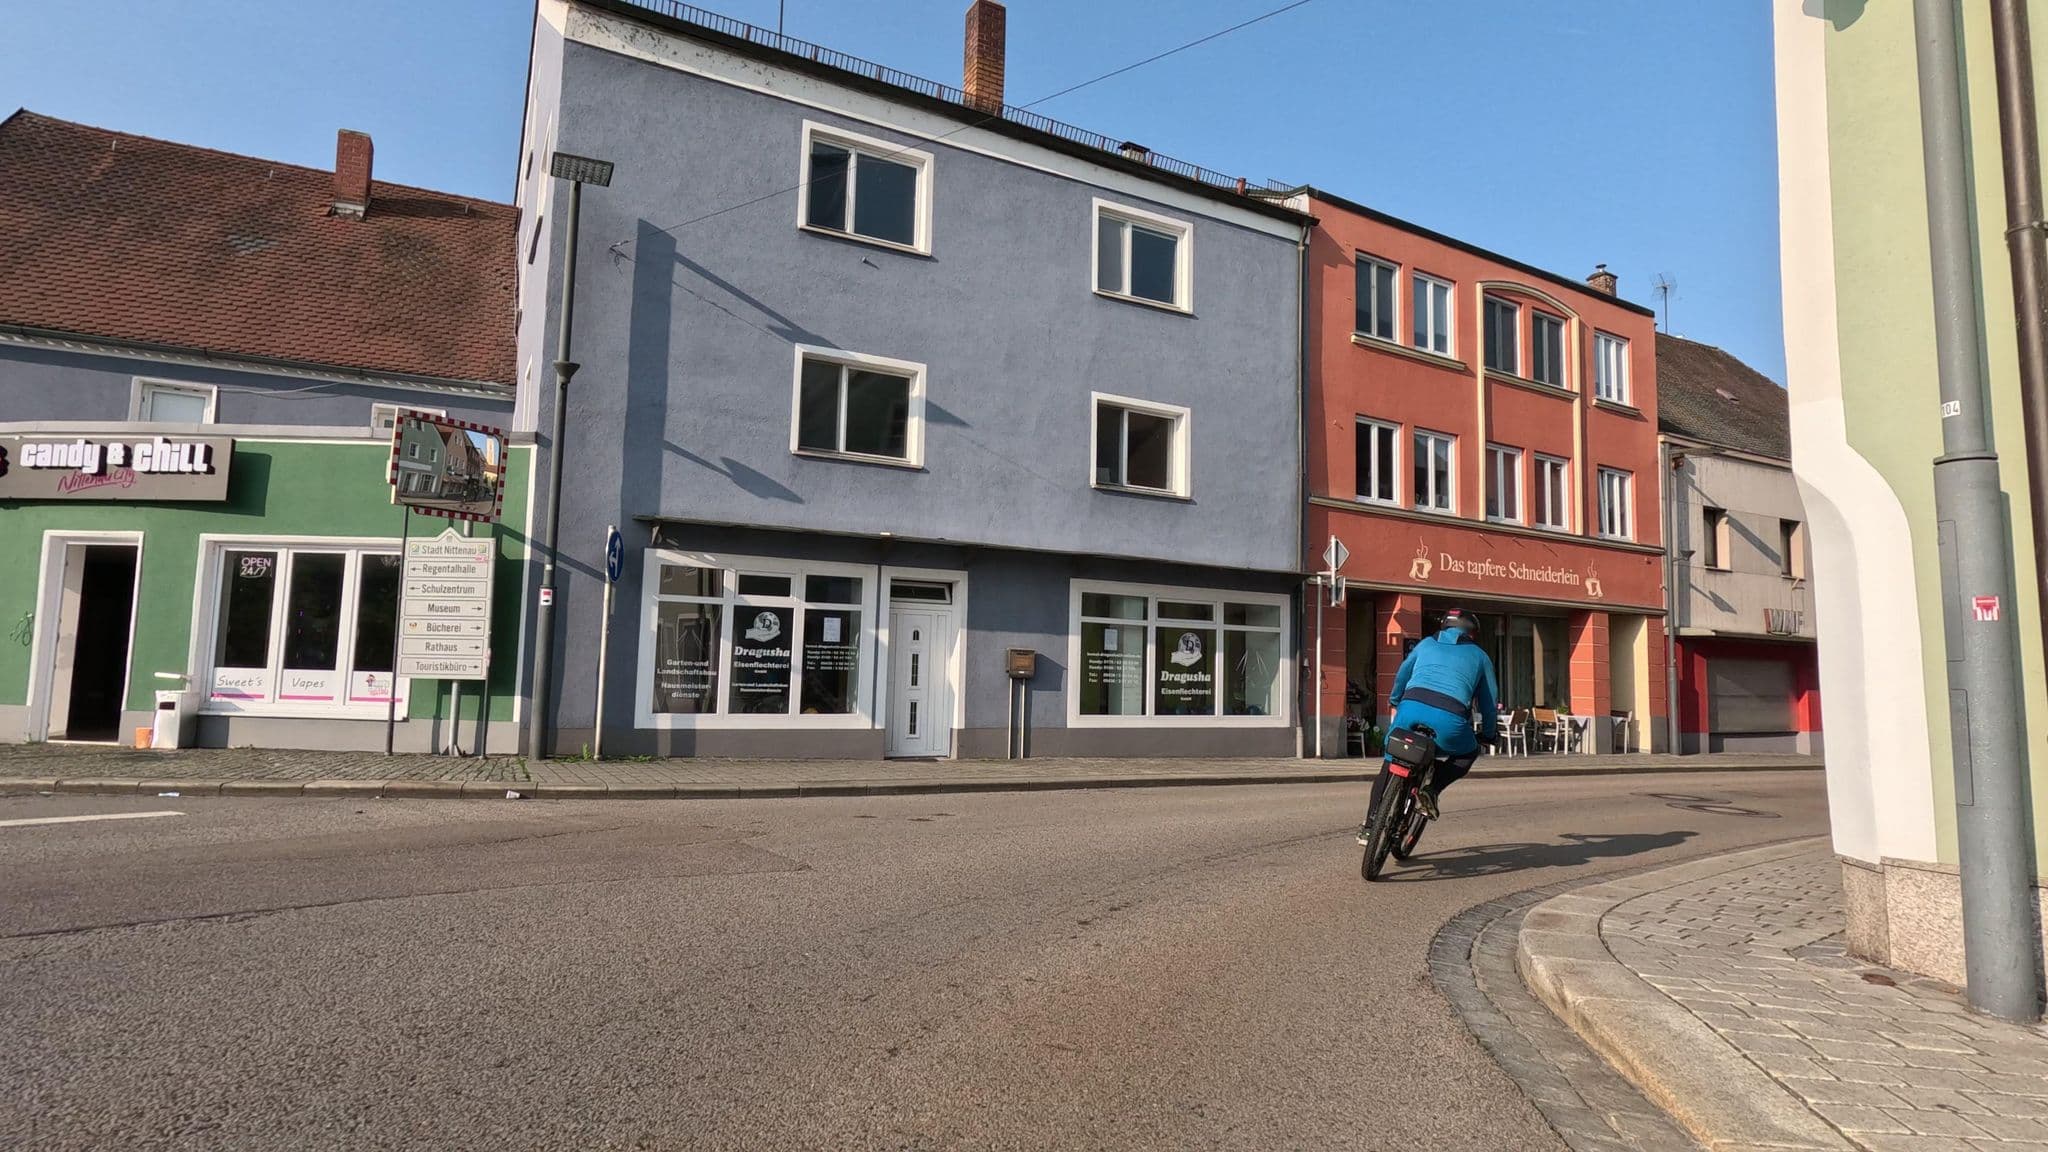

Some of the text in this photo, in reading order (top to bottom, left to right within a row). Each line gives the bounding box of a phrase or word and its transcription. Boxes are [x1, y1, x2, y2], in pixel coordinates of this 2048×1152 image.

[20, 439, 100, 474] candy
[107, 442, 125, 465] &
[422, 544, 477, 555] Stadt Nittenau
[241, 557, 271, 567] OPEN
[240, 566, 267, 577] 24/7
[422, 564, 476, 575] Regentalhalle
[1439, 552, 1580, 586] Das tapfere Schneiderlein
[421, 584, 475, 594] Schulzentrum
[427, 604, 461, 613] Museum
[426, 622, 462, 632] Bücherei
[425, 642, 458, 652] Rathaus
[734, 646, 791, 658] Dragusha
[415, 661, 467, 672] Touristikbüro
[733, 661, 790, 669] Eisenflechterei
[656, 668, 717, 676] Landschaftsbau
[1161, 670, 1212, 685] Dragusha
[292, 677, 325, 689] Vapes
[1161, 687, 1212, 696] Eisenflechterei
